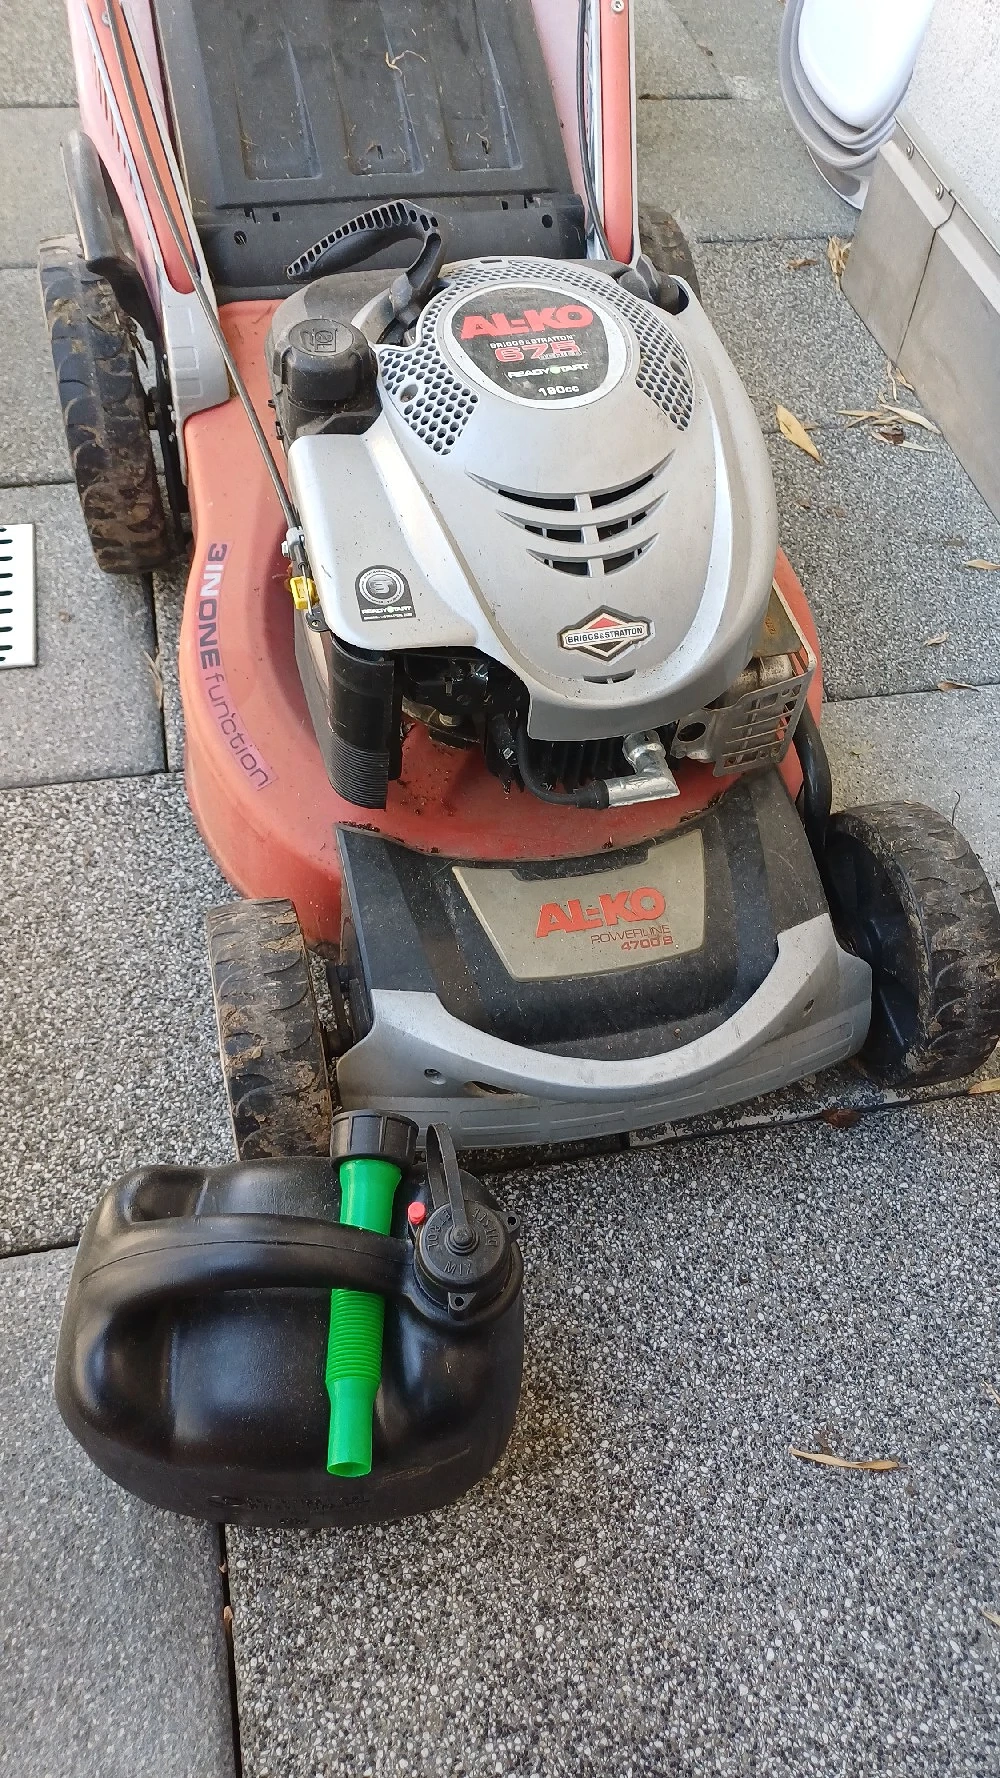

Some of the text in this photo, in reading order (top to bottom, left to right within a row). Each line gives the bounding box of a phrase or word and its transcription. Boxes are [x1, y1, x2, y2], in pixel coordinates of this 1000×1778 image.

[460, 304, 593, 340] AL-KO
[494, 340, 582, 363] 675
[567, 626, 643, 643] BRIGGS&STRATTON
[205, 672, 272, 791] function
[536, 886, 667, 938] AL-KO
[590, 924, 671, 944] POWERLINE
[620, 935, 673, 951] 4700 B
[427, 1210, 452, 1251] ETROL
